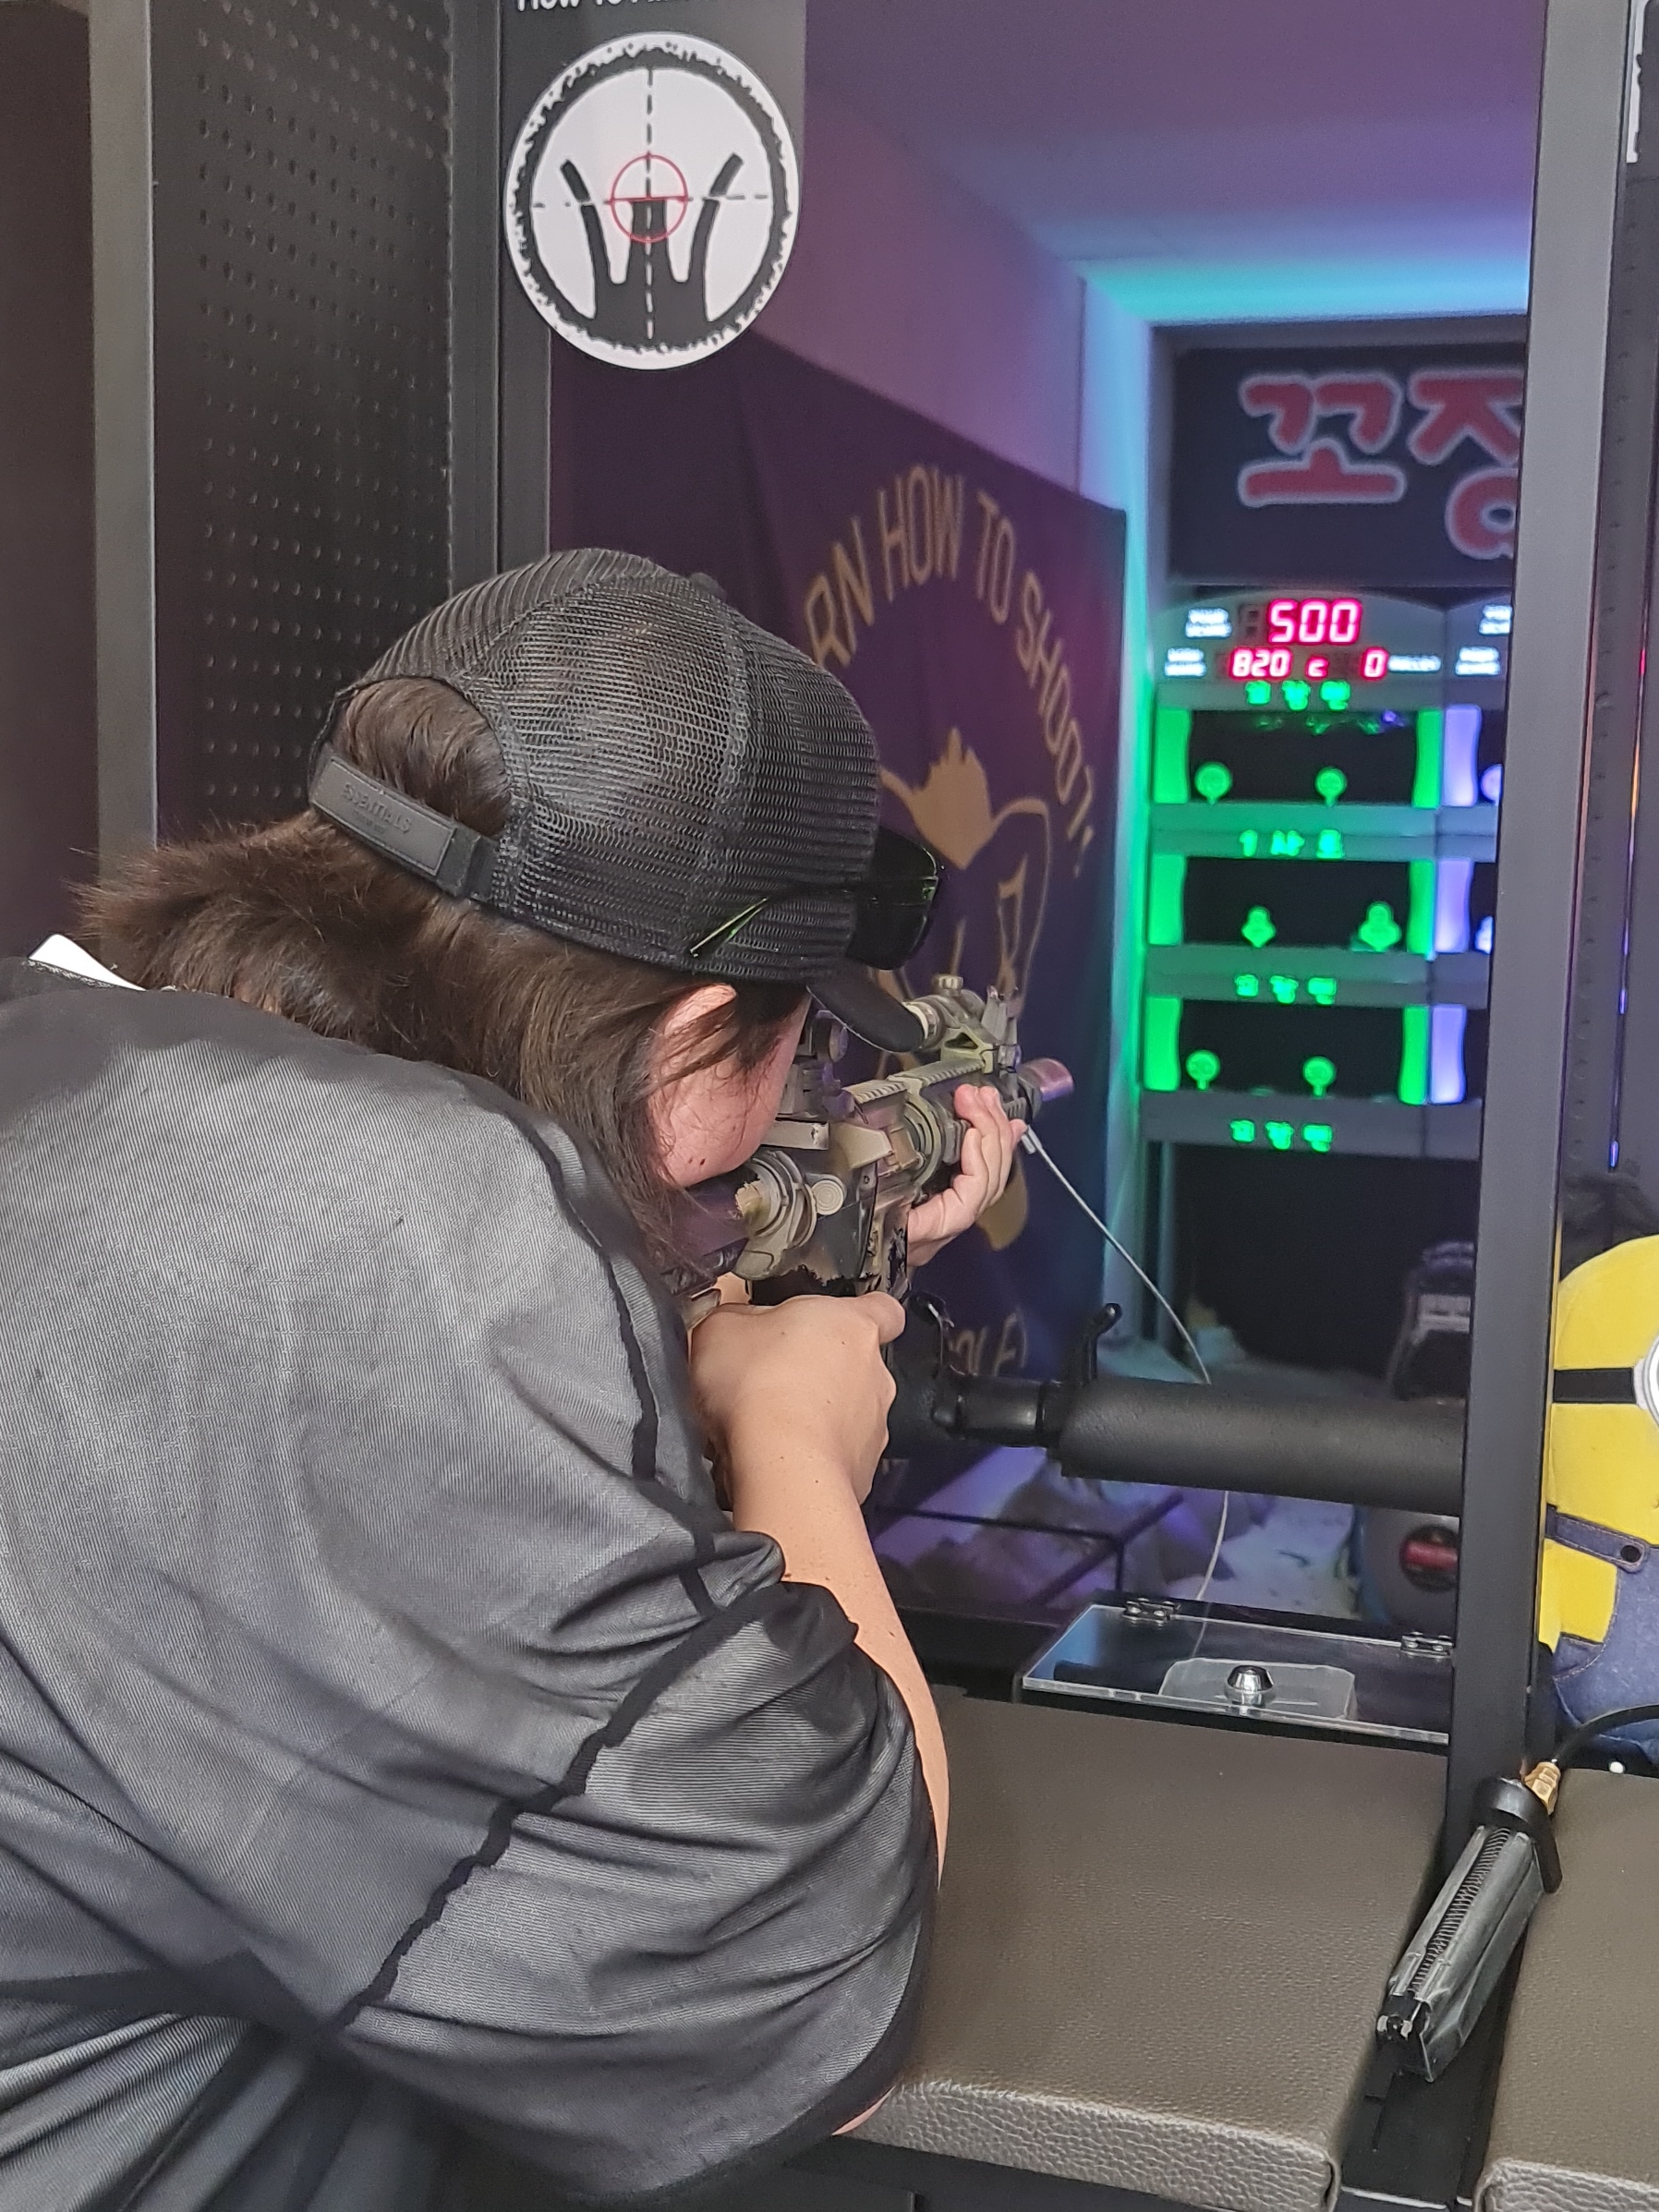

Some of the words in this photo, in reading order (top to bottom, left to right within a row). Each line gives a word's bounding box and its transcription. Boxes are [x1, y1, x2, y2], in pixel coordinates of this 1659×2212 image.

[877, 465, 963, 603] HOW
[975, 489, 1015, 626] TO
[1267, 598, 1362, 644] 500
[1229, 647, 1291, 681] 820
[1362, 647, 1387, 680] 0
